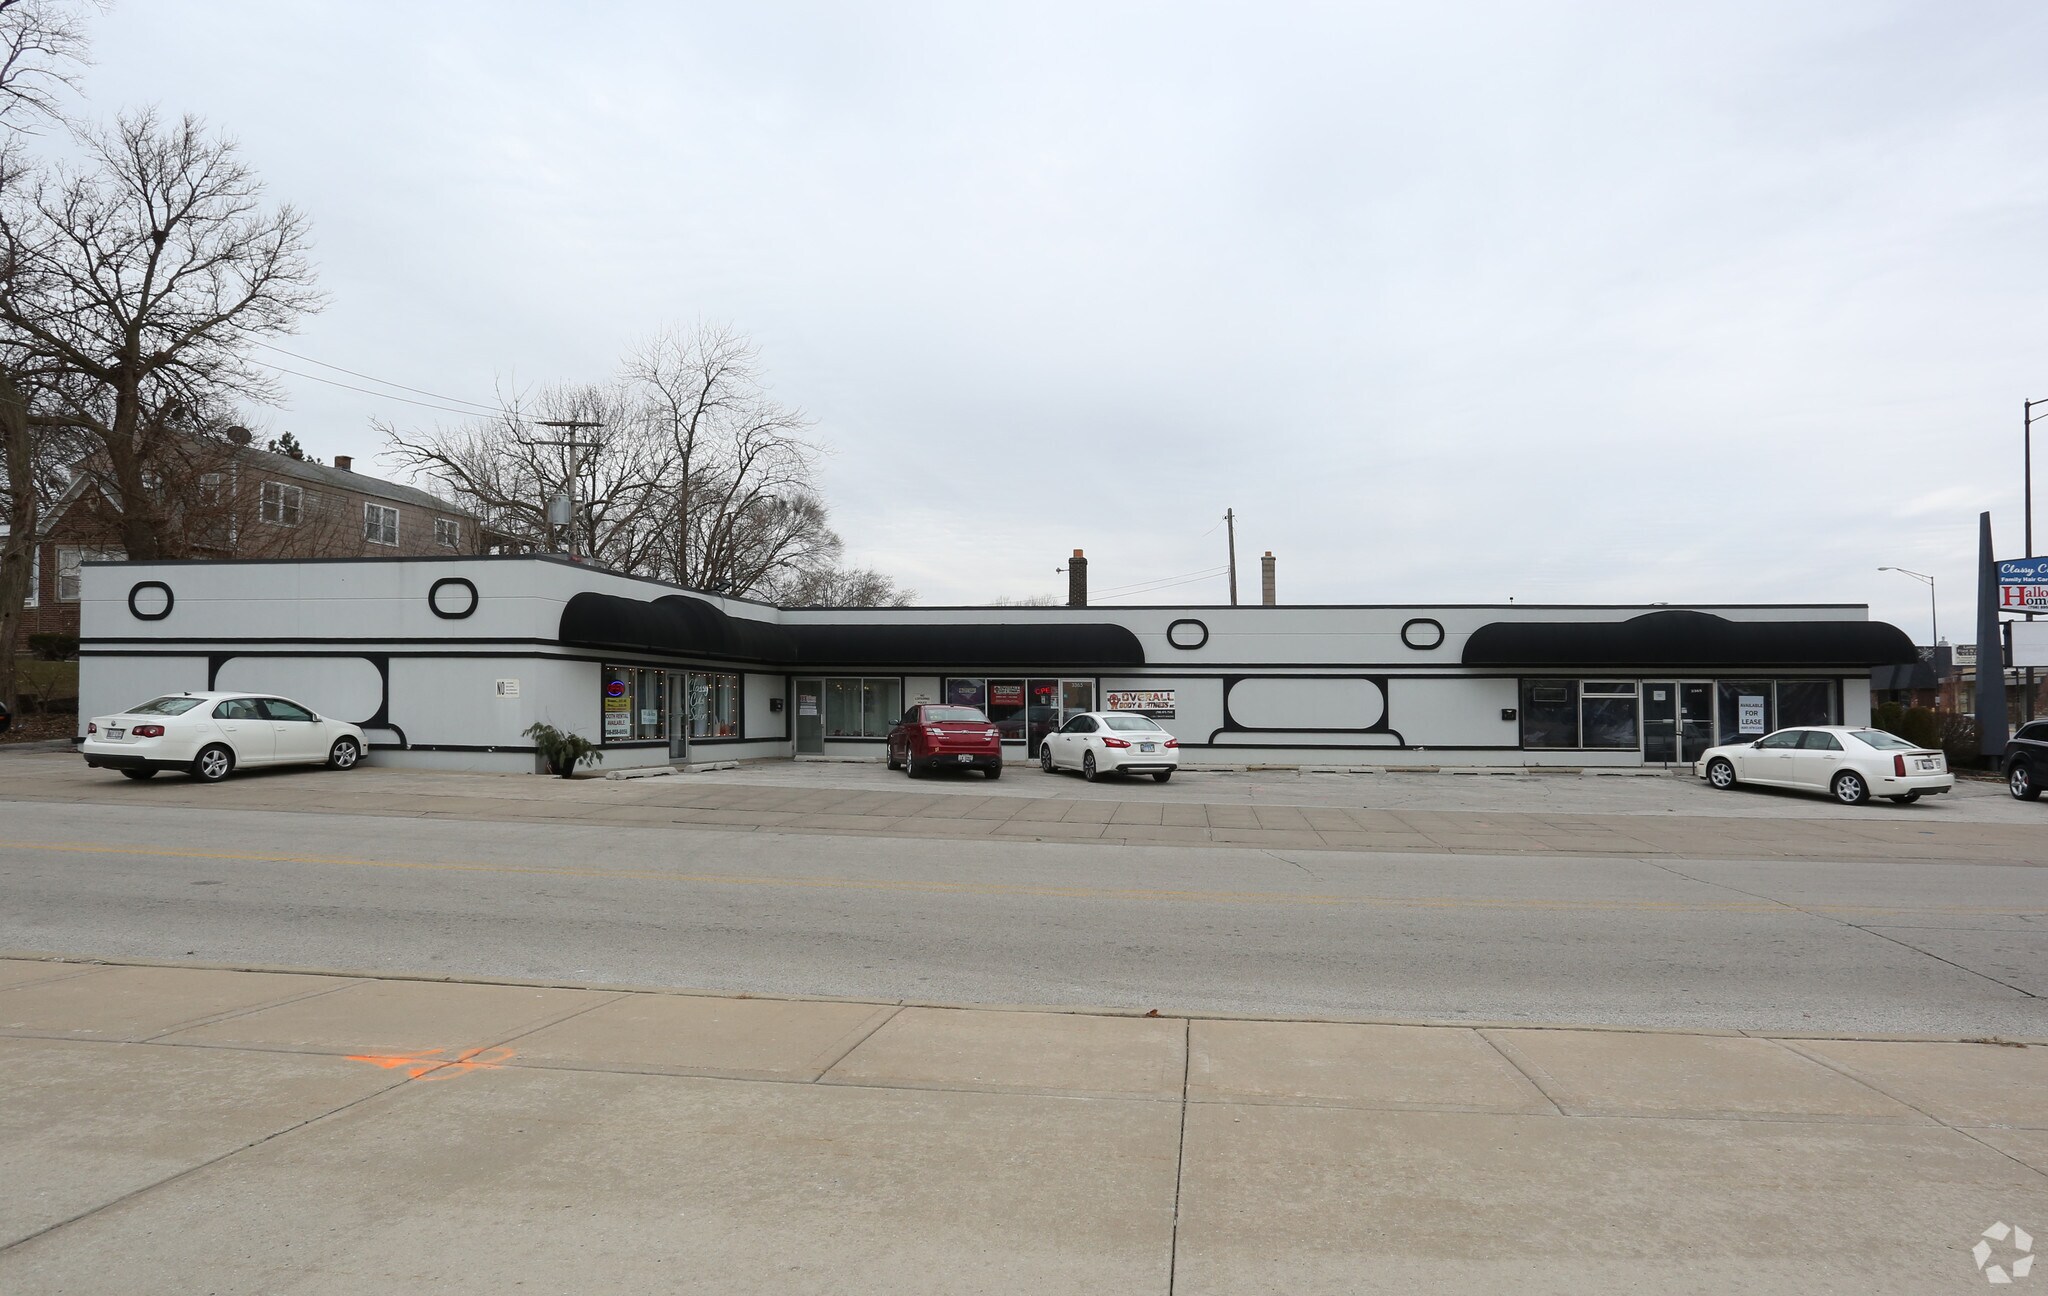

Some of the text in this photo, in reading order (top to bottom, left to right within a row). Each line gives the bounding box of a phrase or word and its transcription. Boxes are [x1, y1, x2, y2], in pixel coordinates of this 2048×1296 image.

[2001, 563, 2048, 576] Classy C
[1121, 692, 1174, 702] OVERALL
